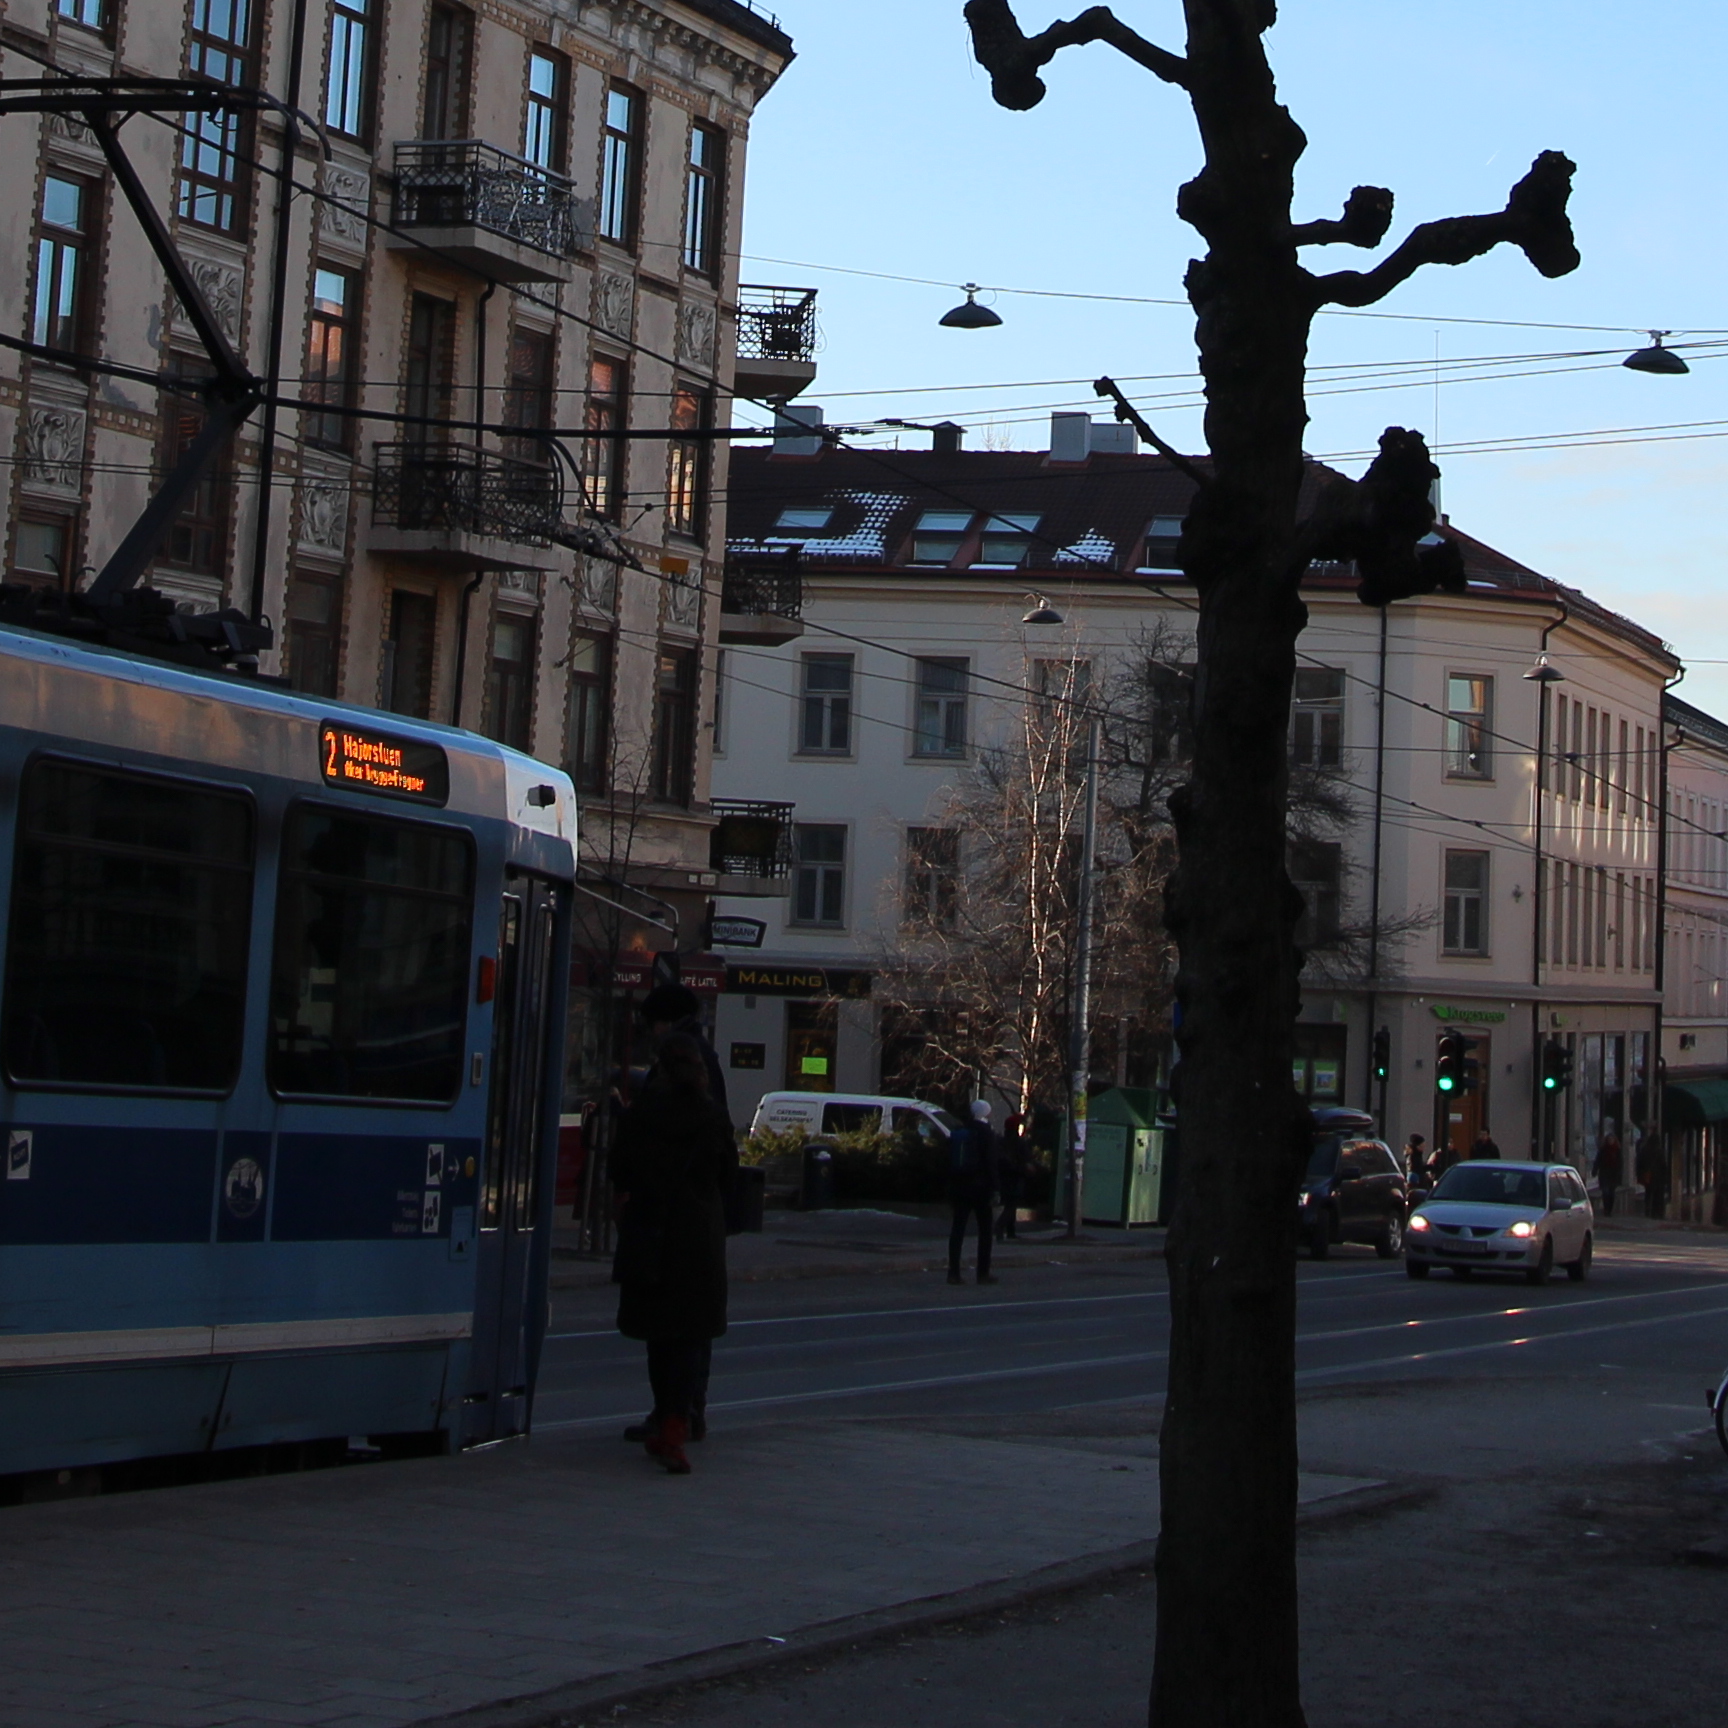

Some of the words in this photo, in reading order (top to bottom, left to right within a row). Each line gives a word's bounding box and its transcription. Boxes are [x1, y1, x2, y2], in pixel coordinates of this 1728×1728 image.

[323, 731, 338, 777] 2
[713, 924, 757, 938] MINIBANK
[613, 971, 642, 983] YLLING
[738, 971, 823, 987] MALING
